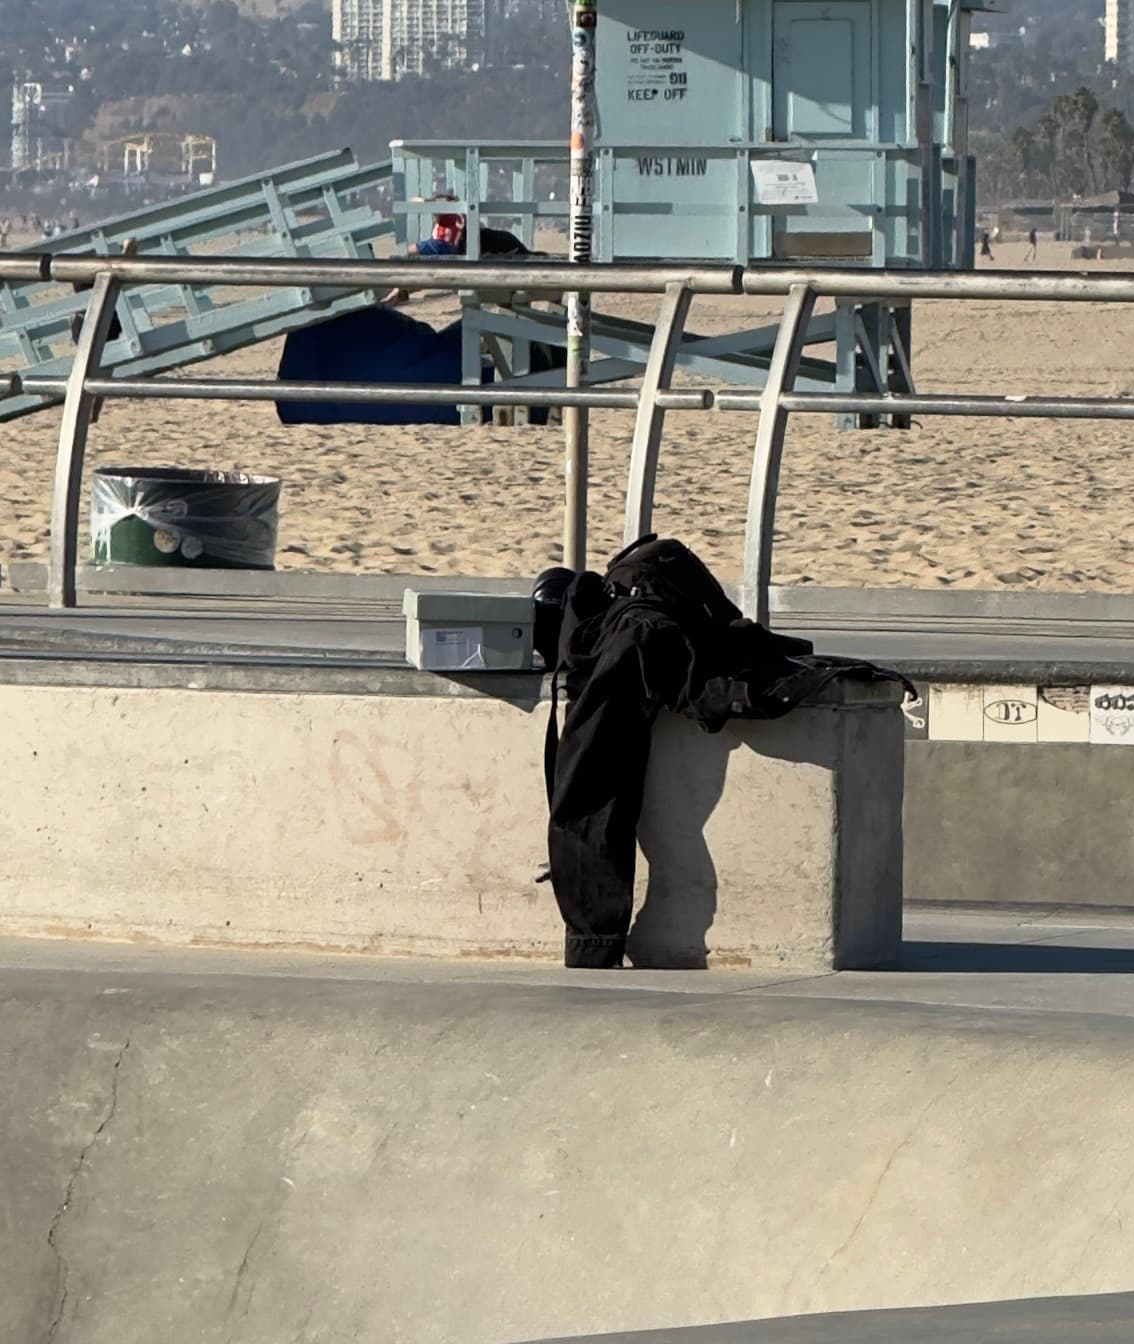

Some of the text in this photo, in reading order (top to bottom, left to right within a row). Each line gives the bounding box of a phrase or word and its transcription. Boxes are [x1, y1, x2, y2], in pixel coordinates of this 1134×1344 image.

[627, 29, 685, 41] LIFEGUARD
[630, 43, 681, 54] OFF-DUTY
[627, 87, 688, 101] KEEP OFF
